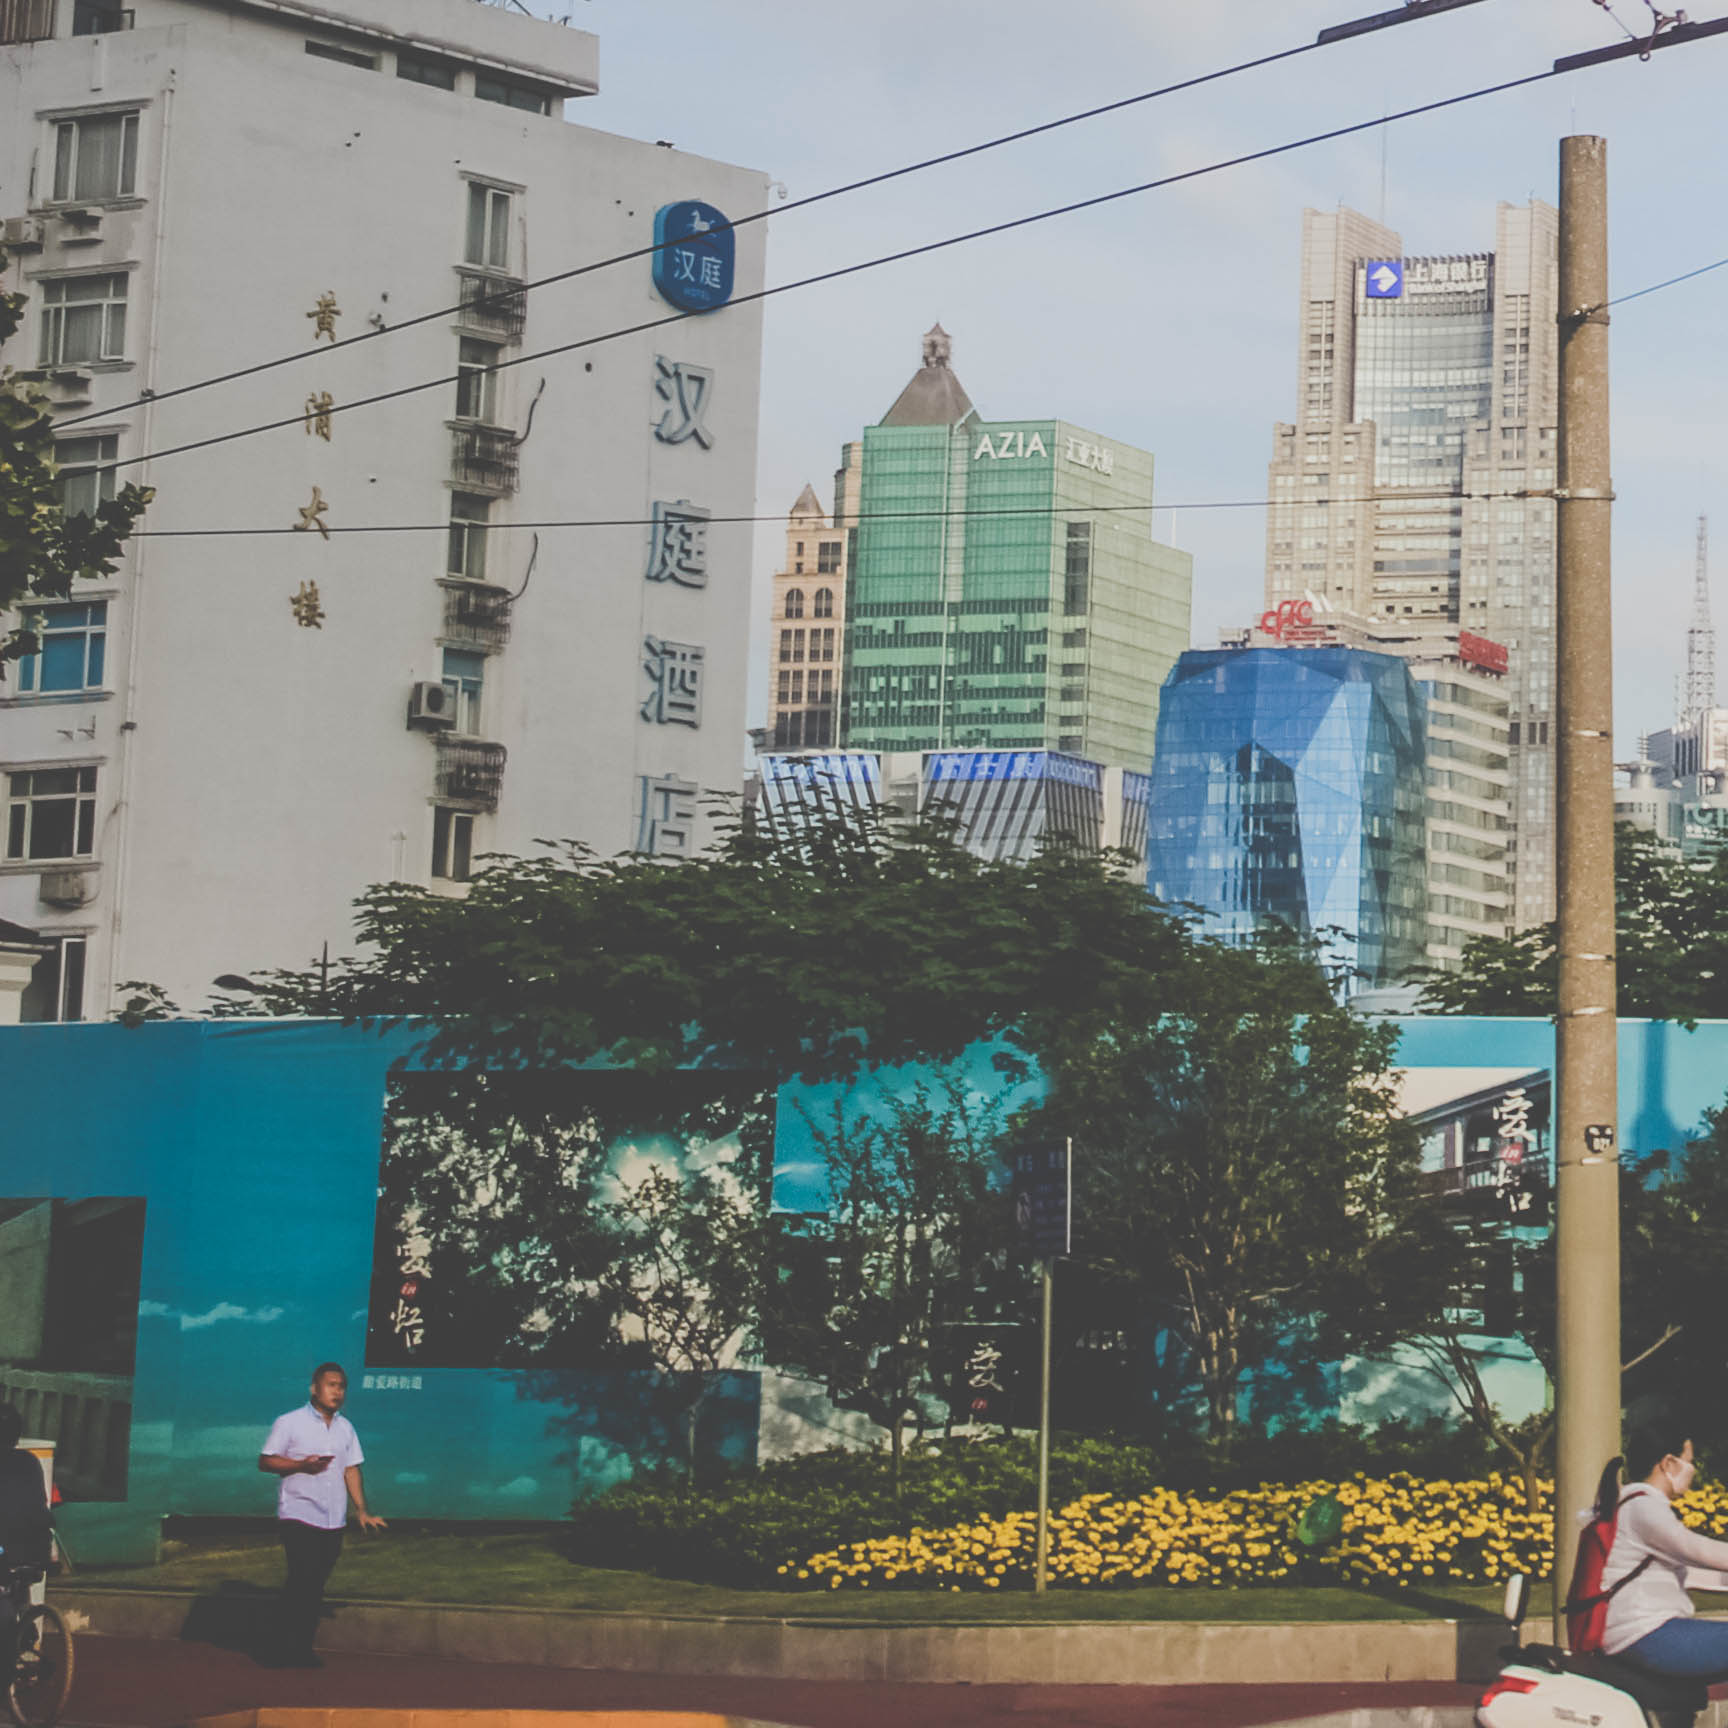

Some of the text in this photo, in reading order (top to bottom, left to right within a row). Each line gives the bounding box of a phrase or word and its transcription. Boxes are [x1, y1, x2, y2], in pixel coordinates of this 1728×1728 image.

[673, 248, 723, 289] 汉庭
[974, 431, 1049, 461] AZIA
[634, 353, 716, 858] 汉庭酒店
